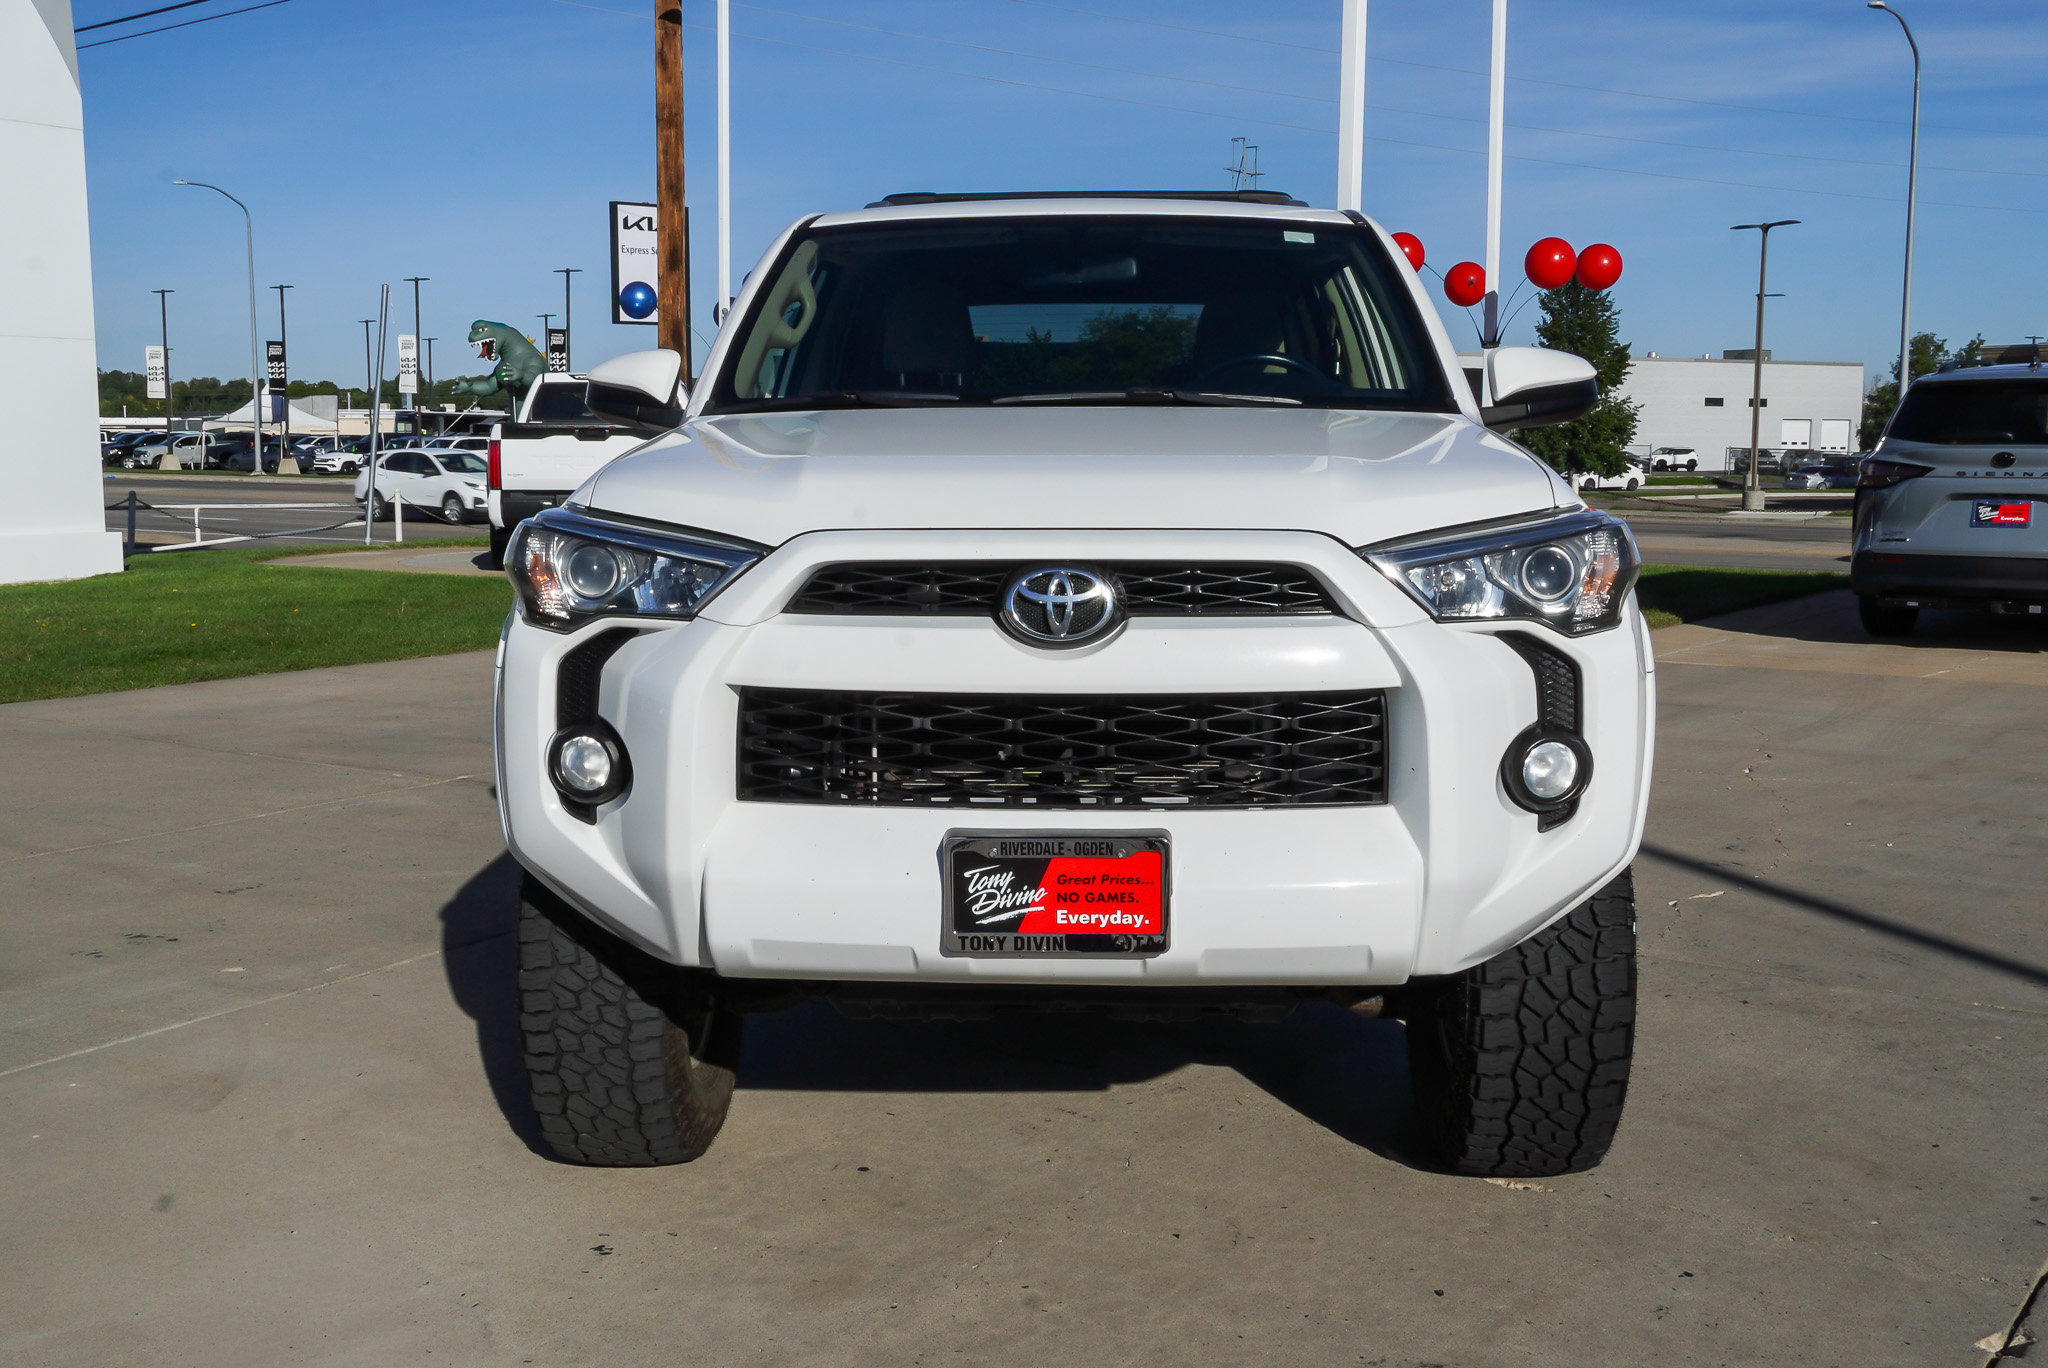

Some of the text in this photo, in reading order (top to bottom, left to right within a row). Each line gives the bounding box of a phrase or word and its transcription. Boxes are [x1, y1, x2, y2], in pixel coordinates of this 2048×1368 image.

[623, 215, 658, 231] KI
[621, 245, 649, 255] Express
[1000, 841, 1066, 856] RIVERDALE
[1074, 841, 1114, 856] OGDEN
[963, 865, 1016, 894] Tony
[1056, 873, 1155, 886] Great Prices...
[964, 886, 1048, 915] Divino
[1056, 892, 1140, 904] NO GAMES.
[1056, 909, 1150, 928] Everyday.
[958, 935, 1008, 951] TONY
[1014, 935, 1067, 951] DIVIN
